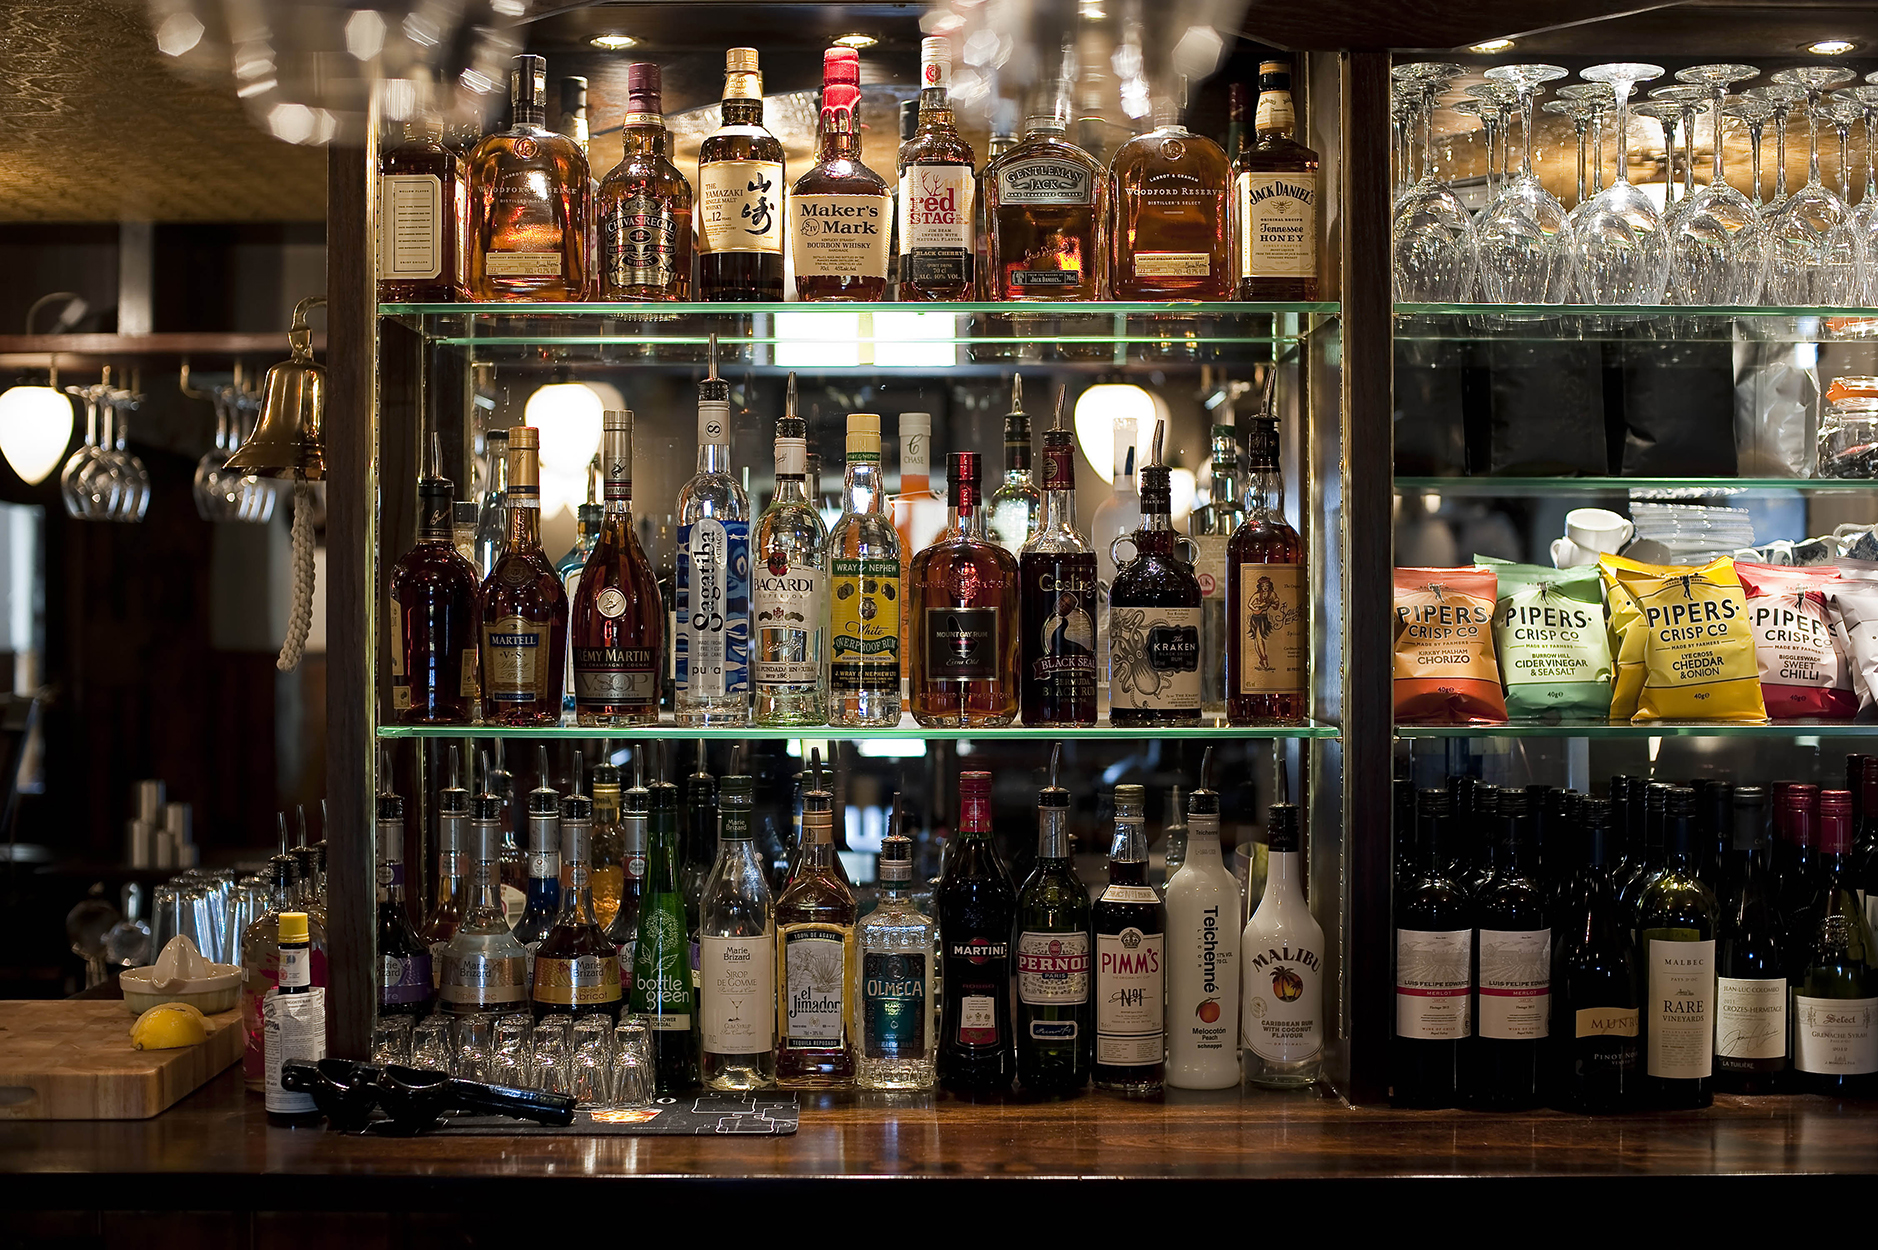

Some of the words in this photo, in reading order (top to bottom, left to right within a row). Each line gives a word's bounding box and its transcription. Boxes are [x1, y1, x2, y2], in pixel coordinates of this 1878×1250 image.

[1006, 165, 1084, 183] GENTLEMAN
[1149, 174, 1170, 183] LABROT
[1177, 174, 1199, 183] GRAHAM
[705, 182, 716, 190] THE
[1030, 178, 1058, 191] JACK
[705, 189, 743, 198] YAMAZAKI
[1124, 187, 1178, 196] WOODFORD
[1181, 187, 1225, 196] RESERVE
[1249, 185, 1274, 205] JACK
[1276, 181, 1315, 205] DANIEL'S
[910, 188, 956, 212] red
[800, 204, 878, 217] Maker's
[712, 211, 721, 222] 12
[910, 212, 955, 224] STAG
[607, 215, 641, 232] CHIVAS
[644, 216, 674, 232] REGAL
[822, 221, 878, 234] Mark
[1260, 222, 1304, 233] Tennessee
[635, 230, 645, 240] 12
[1260, 234, 1304, 242] HONEY
[903, 456, 924, 464] CHASE
[837, 563, 858, 572] WRAY
[869, 563, 897, 572] NEPHEW
[692, 530, 723, 632] Sagatiba
[754, 578, 814, 592] BACARDI
[1200, 577, 1211, 586] UK
[1397, 606, 1487, 626] PIPERS
[1505, 606, 1586, 629] PIPERS
[1646, 599, 1735, 628] PIPERS
[845, 621, 889, 636] White
[1408, 624, 1452, 639] CRISP
[1457, 626, 1478, 637] CO
[1660, 625, 1704, 642] CRISP
[1707, 623, 1728, 637] CO
[491, 635, 536, 645] MARTELL
[1515, 628, 1556, 641] CRISP
[1560, 631, 1579, 642] CO
[1765, 630, 1810, 643] CRISP
[835, 637, 881, 652] OVERPROOF
[882, 638, 896, 649] RUM
[1153, 642, 1196, 651] KRAKEN
[1696, 640, 1720, 648] FARMERS
[576, 648, 602, 662] RÉMY
[605, 649, 650, 662] MARTIN
[1417, 654, 1470, 665] CHORIZO
[1041, 658, 1075, 669] BLACK
[1078, 658, 1095, 668] SEAL
[1515, 659, 1544, 668] CIDER
[1546, 659, 1588, 668] VINEGAR
[1672, 656, 1724, 671] CHEDDAR
[1784, 661, 1816, 669] SWEET
[692, 666, 721, 676] pura
[1530, 668, 1537, 676] &
[1538, 668, 1555, 676] SEA
[1556, 668, 1576, 676] SALT
[1780, 669, 1819, 680] CHILLI
[579, 674, 648, 692] VSOP
[1055, 678, 1090, 686] BERMUDA
[1042, 687, 1078, 696] BLACK
[818, 932, 836, 940] AGAVE
[954, 945, 1004, 955] MARTINI
[1203, 905, 1219, 994] Teichenné
[723, 953, 750, 961] Brizard
[1101, 948, 1159, 974] PIMM'S
[1251, 947, 1322, 974] MALIBU
[464, 960, 488, 970] Marie
[576, 960, 601, 969] Marie
[1018, 956, 1090, 971] PERNOD
[460, 968, 491, 978] Brizard
[572, 969, 603, 977] Brizard
[726, 970, 748, 978] SIROP
[637, 973, 682, 990] bottle
[728, 978, 757, 987] GOMME
[801, 986, 811, 1000] el
[867, 980, 923, 997] OLMECA
[455, 991, 476, 1000] Triple
[571, 992, 608, 1001] Abricot
[646, 990, 689, 1010] green
[789, 995, 841, 1018] Jimador
[1663, 1000, 1704, 1013] RARE
[1723, 1005, 1782, 1014] CROZES-HERMITAGE
[1823, 1014, 1856, 1024] Select
[1192, 1027, 1226, 1035] Melocotón
